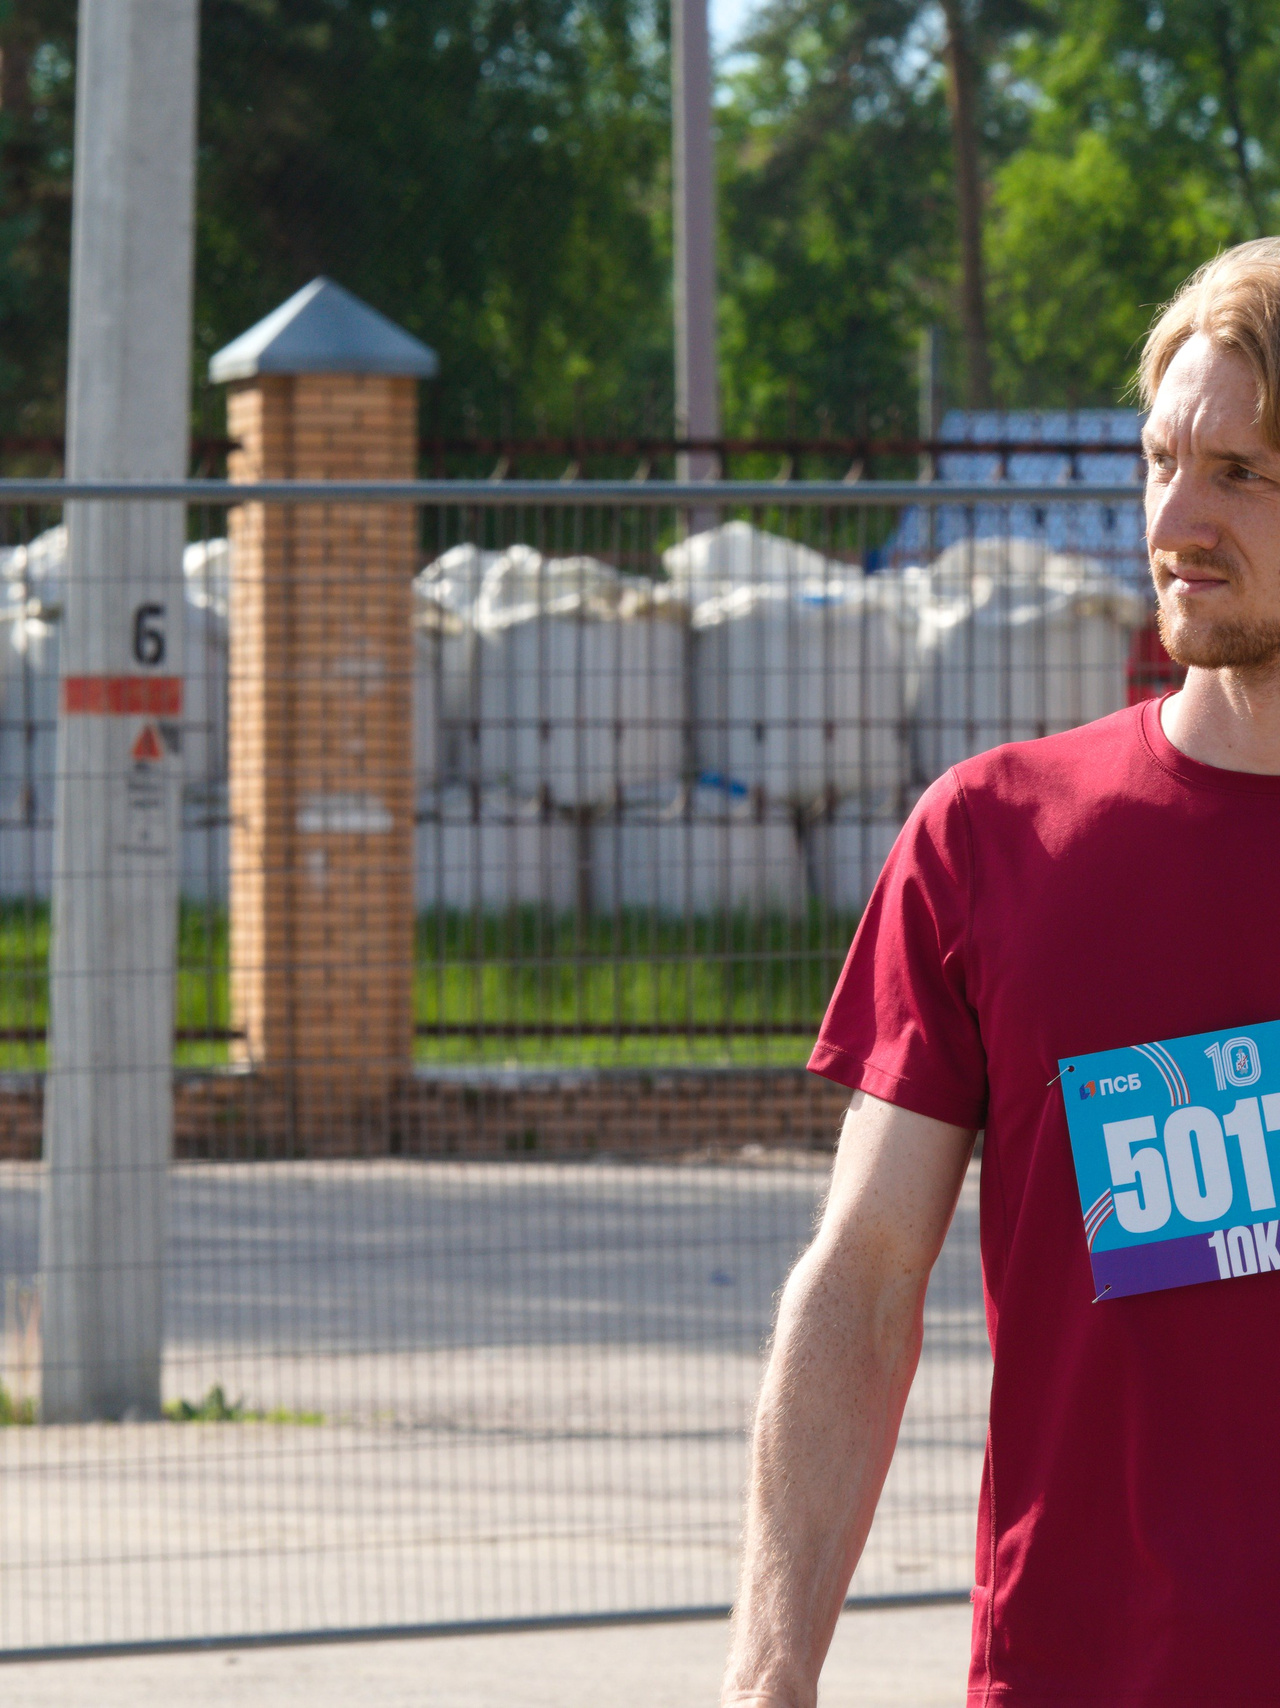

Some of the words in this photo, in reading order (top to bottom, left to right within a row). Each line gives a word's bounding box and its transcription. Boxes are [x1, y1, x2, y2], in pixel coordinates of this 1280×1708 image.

[133, 602, 165, 665] 6
[1099, 1073, 1142, 1097] ПСБ
[1204, 1036, 1262, 1091] 10
